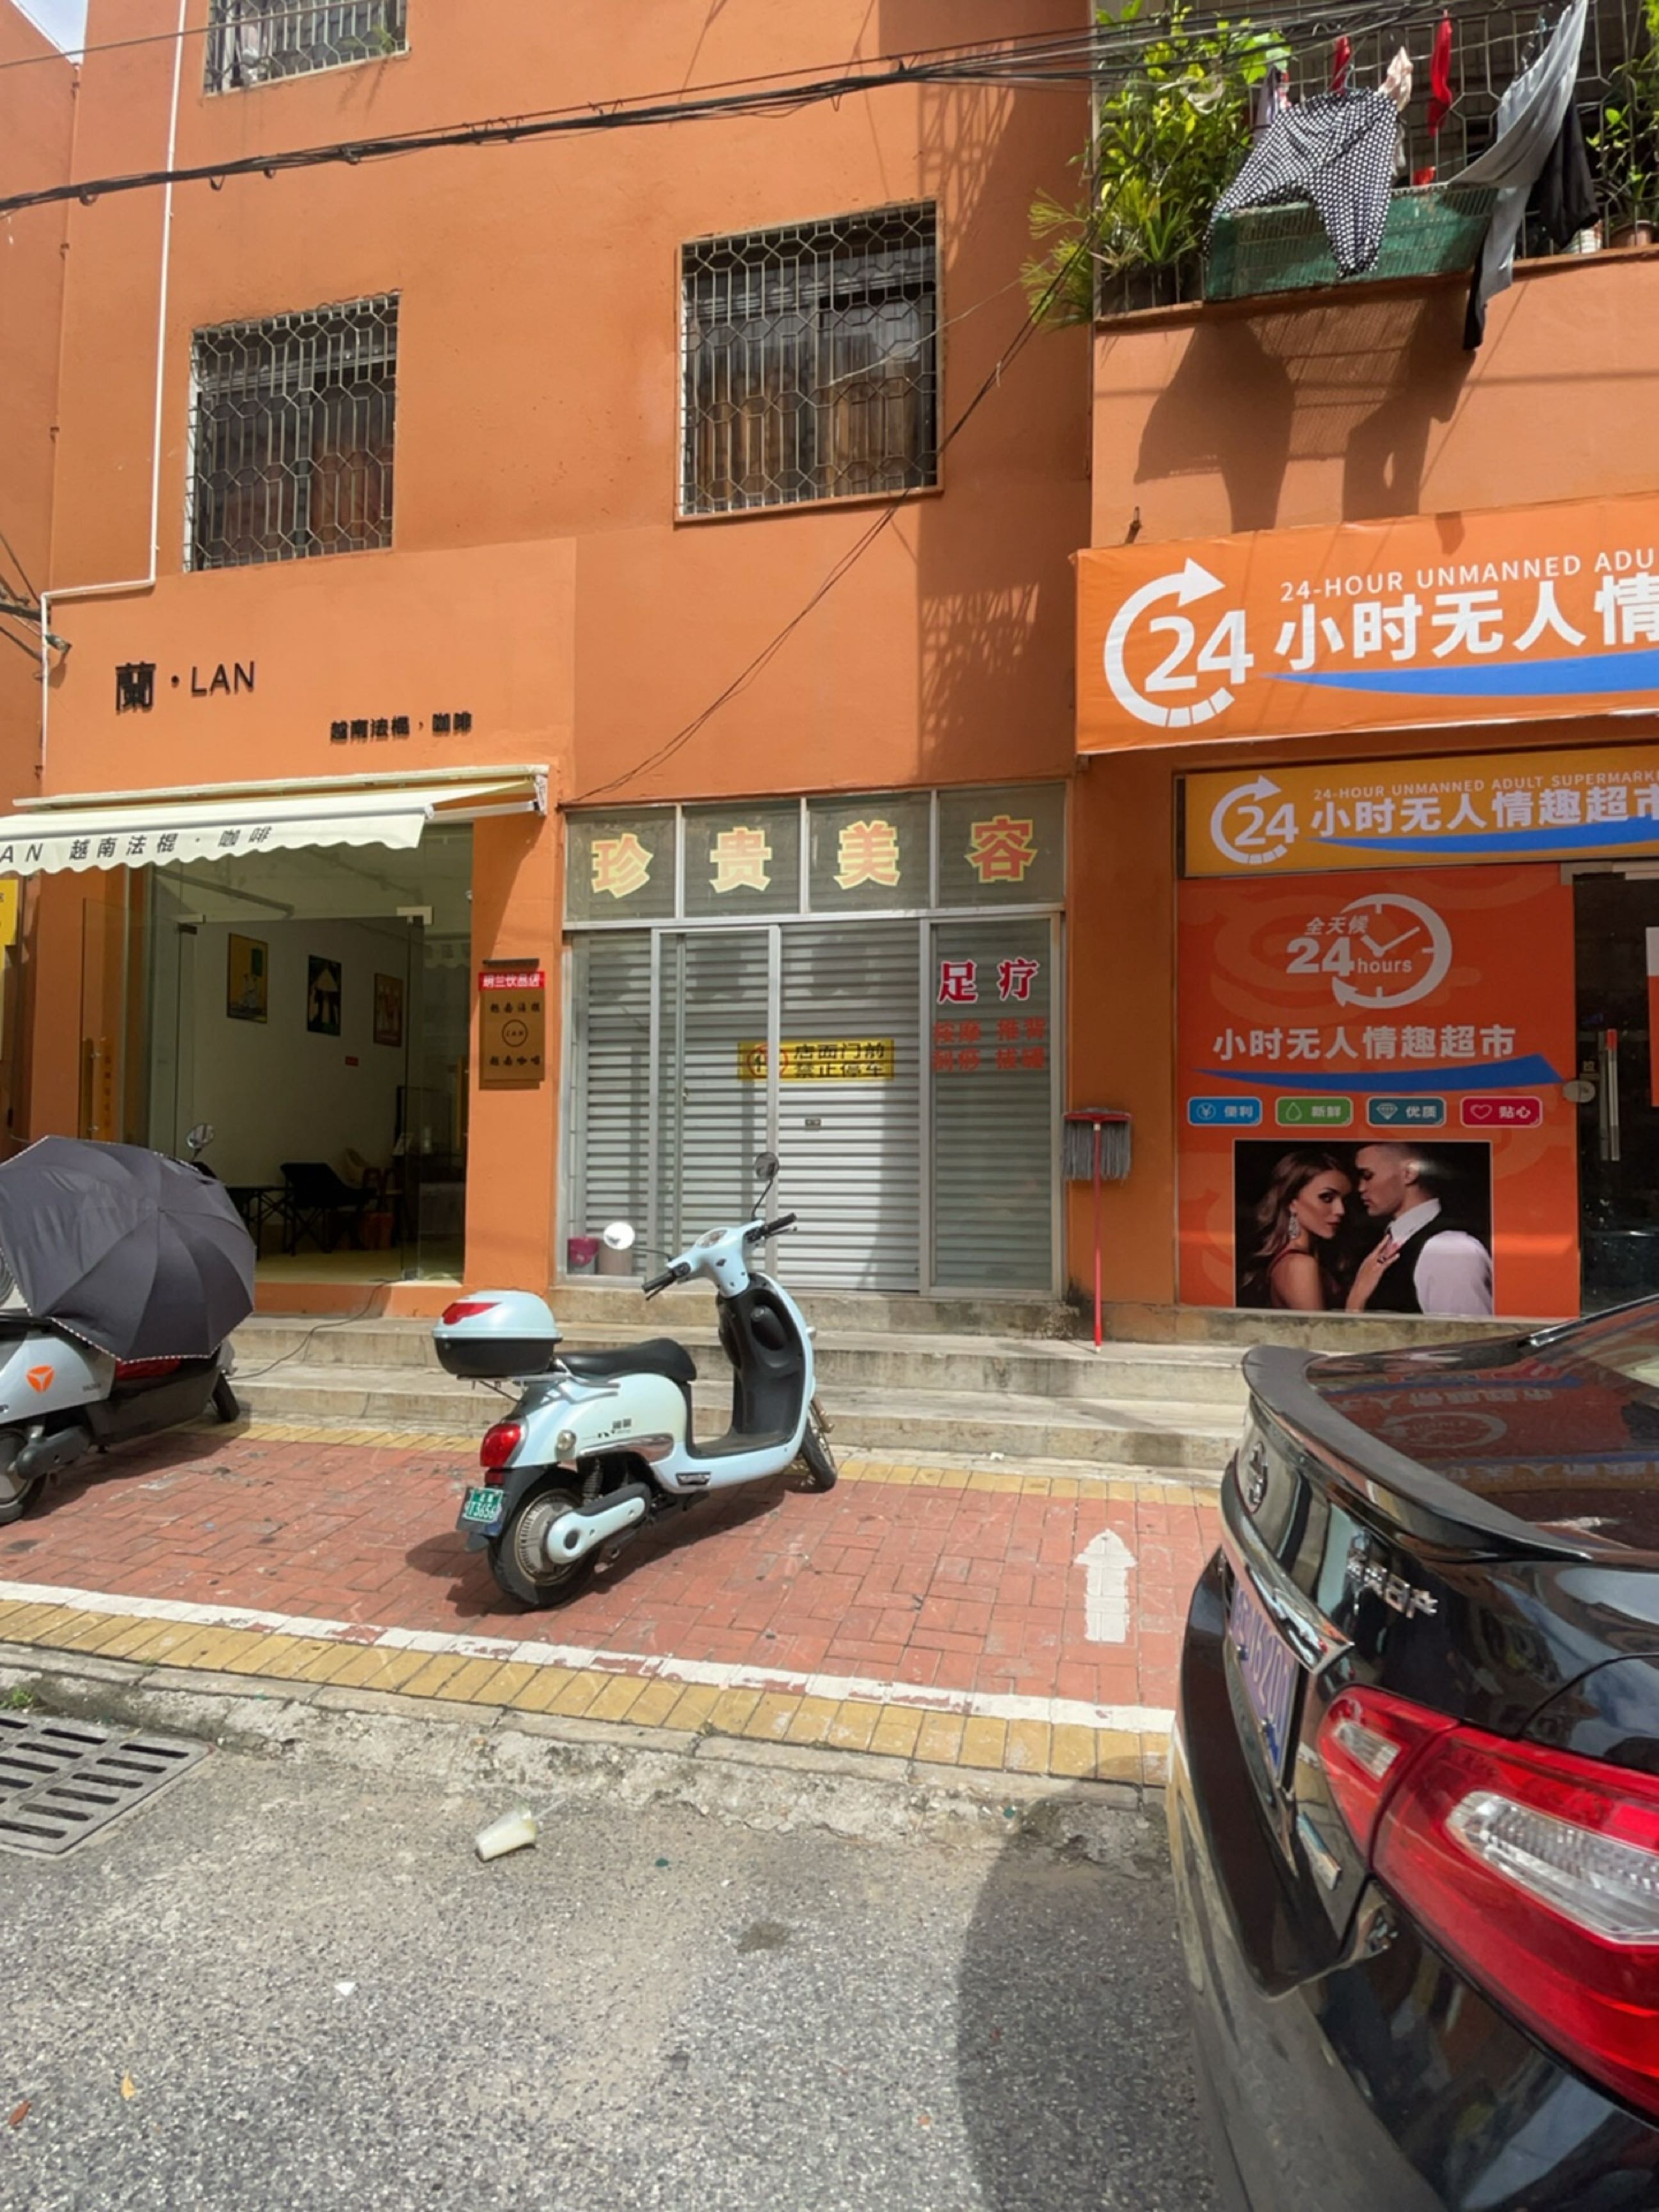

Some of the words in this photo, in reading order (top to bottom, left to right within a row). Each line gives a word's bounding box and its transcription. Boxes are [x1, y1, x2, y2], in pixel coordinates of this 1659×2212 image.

[1280, 571, 1403, 602] 24-HOUR
[1416, 555, 1582, 589] UNMANNED
[1594, 547, 1654, 573] ADU
[1274, 572, 1659, 671] 小时无人情
[1144, 609, 1254, 693] 24
[1313, 785, 1384, 801] 24-HOUR
[1391, 778, 1485, 796] UNMANNED
[1491, 775, 1544, 790] ADULT
[1551, 770, 1659, 787] SUPERMARK
[1234, 803, 1300, 846] 24
[591, 815, 1039, 899] 珍贵美容
[1304, 915, 1370, 936] 全天候
[1285, 936, 1354, 977] 24
[1357, 957, 1413, 974] hours
[936, 958, 1041, 1005] 足疗
[1212, 1023, 1516, 1061] 小时无人情趣超市
[1224, 1105, 1254, 1119] 便利
[1406, 1105, 1438, 1119] 优质
[1499, 1105, 1532, 1119] 贴心
